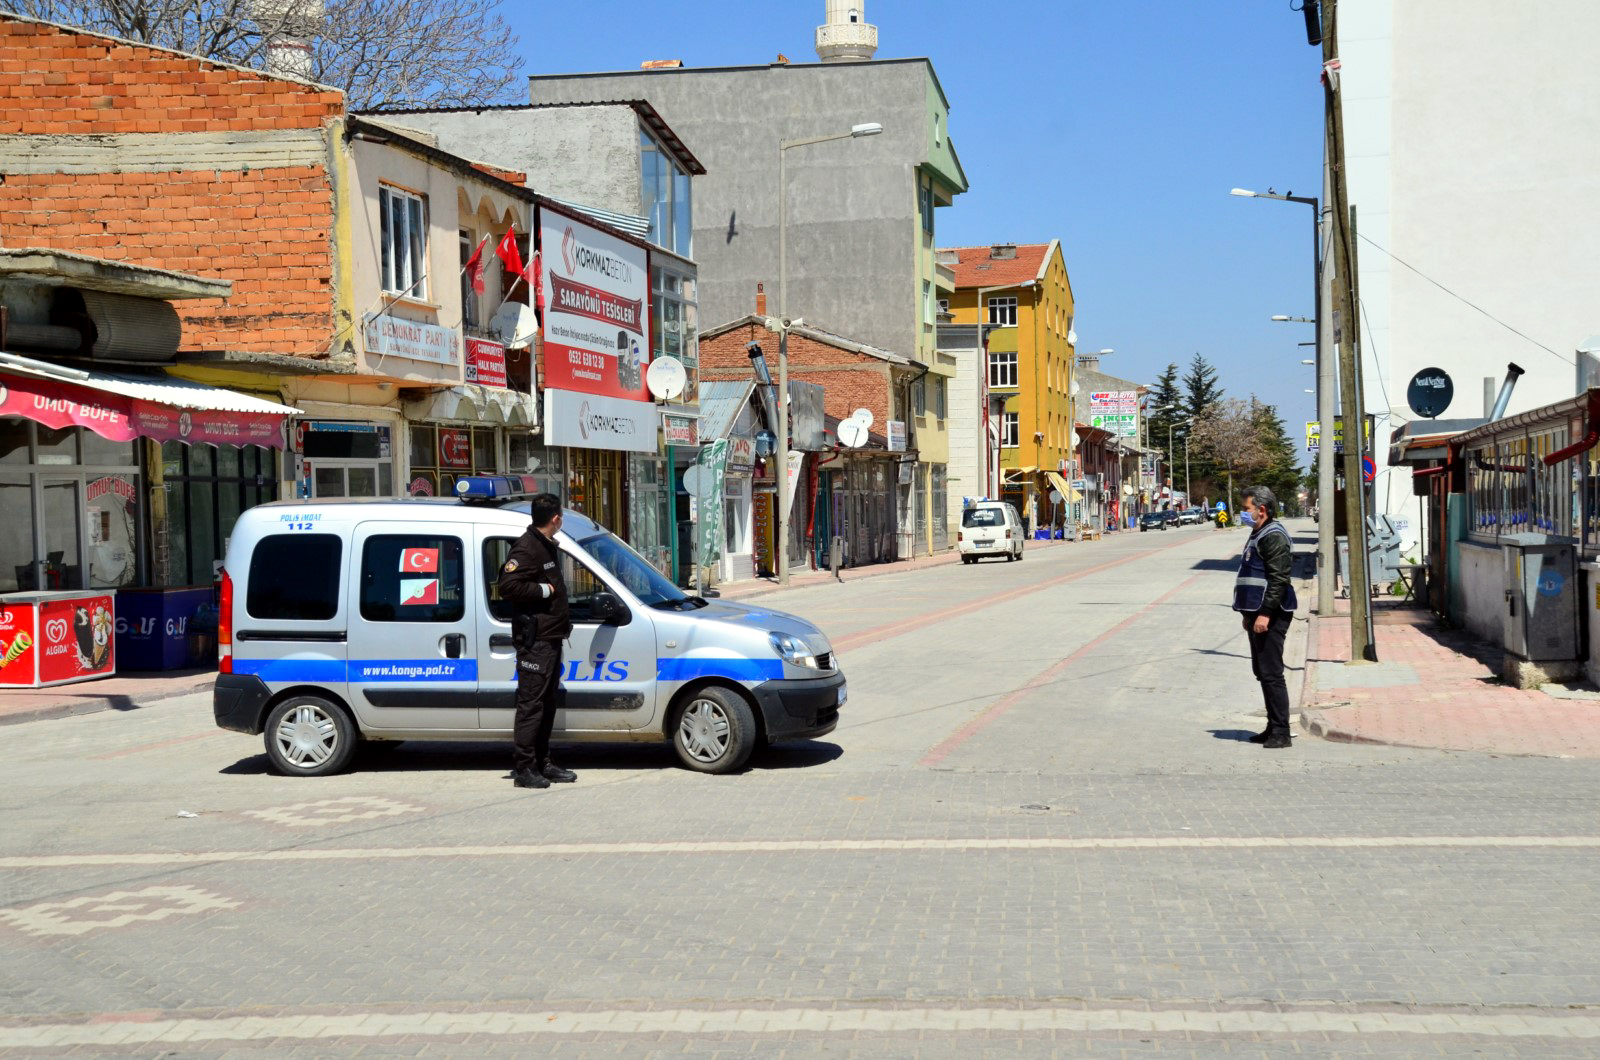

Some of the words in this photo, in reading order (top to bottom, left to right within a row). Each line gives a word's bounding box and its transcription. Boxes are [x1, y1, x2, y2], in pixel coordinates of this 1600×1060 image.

[575, 245, 632, 283] KORKMAZBETON
[560, 288, 601, 315] SARAYÖNÜ
[601, 299, 636, 325] TESİSLERİ
[568, 349, 582, 365] 0532
[466, 366, 477, 379] CHP
[34, 394, 77, 415] UMUT
[79, 403, 120, 423] BÜFE
[203, 422, 222, 435] UMUT
[223, 420, 239, 436] BÜFE
[87, 476, 113, 503] UMUT
[288, 522, 313, 530] 112
[45, 646, 68, 656] ALGIDA
[363, 664, 455, 679] www.konya.pol.tr
